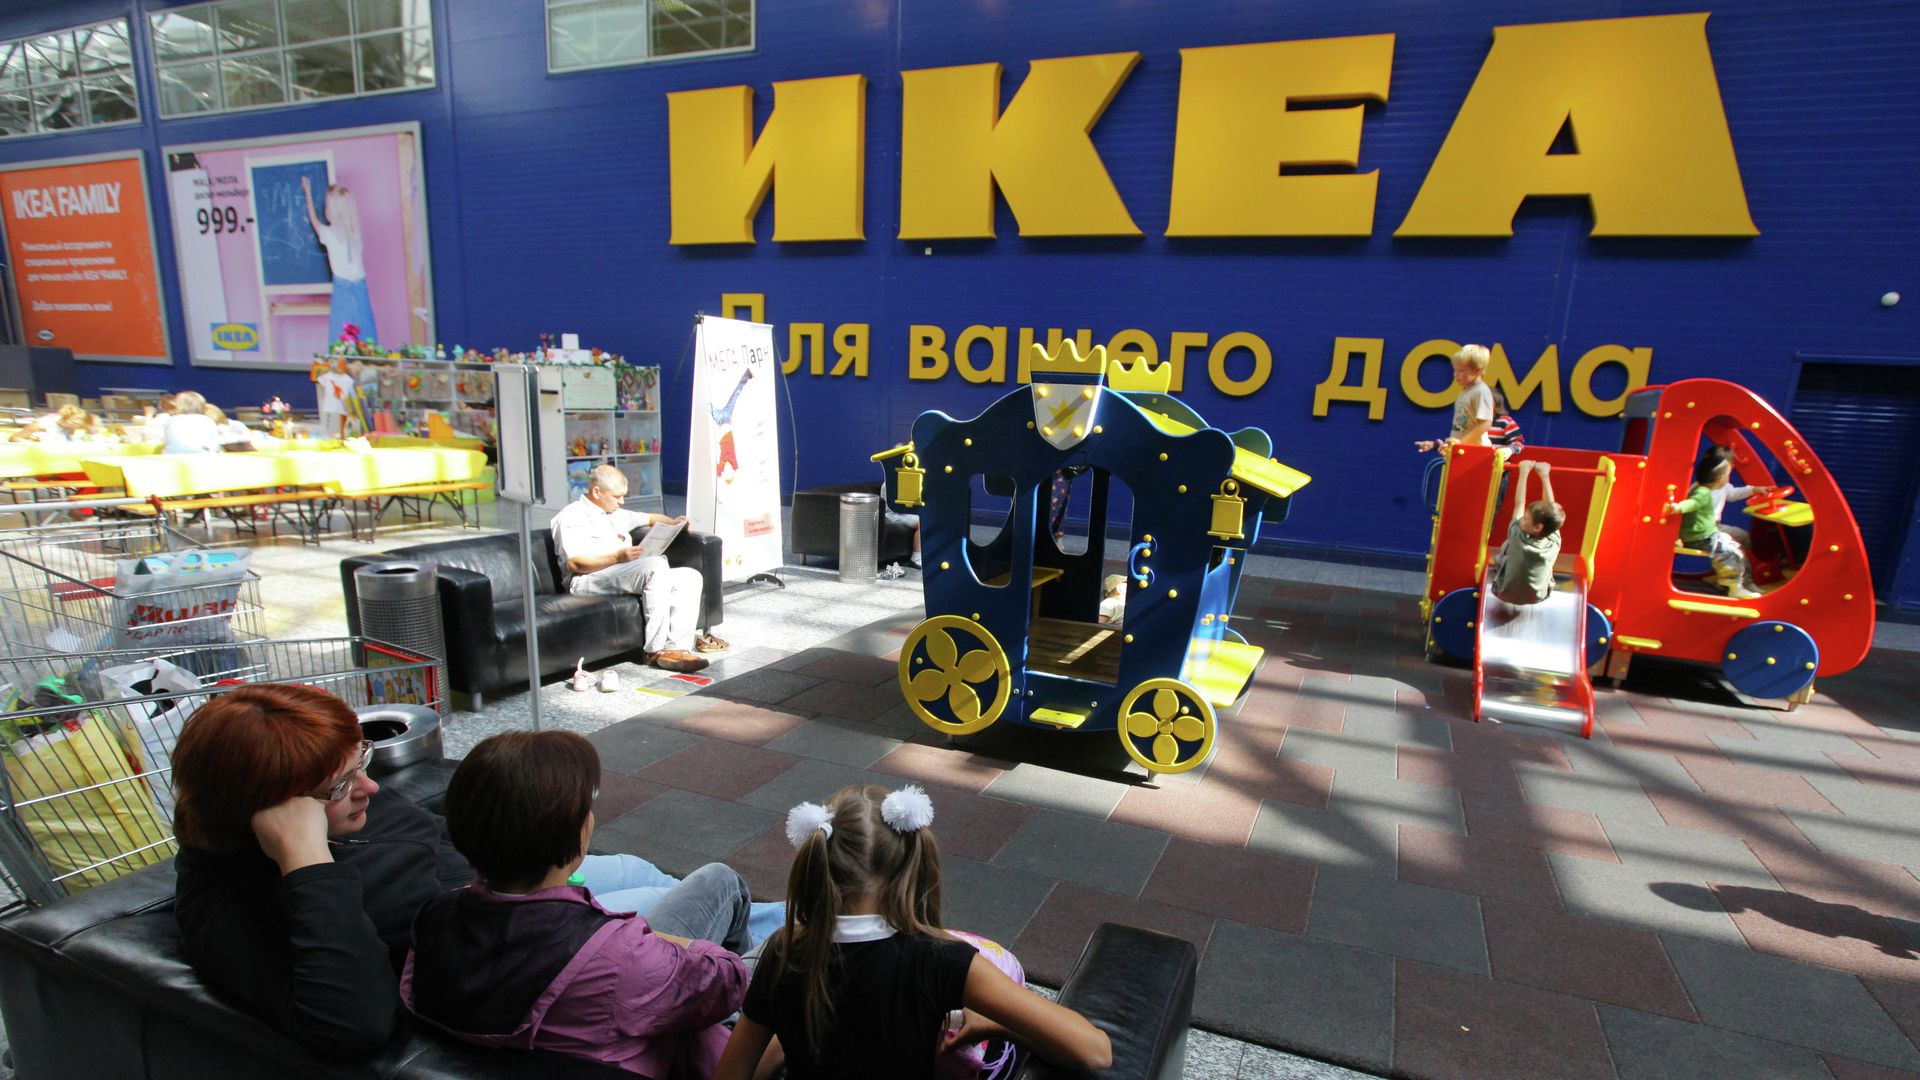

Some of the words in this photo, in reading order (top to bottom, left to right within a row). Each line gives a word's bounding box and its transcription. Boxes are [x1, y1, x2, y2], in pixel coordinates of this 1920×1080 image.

[666, 12, 1760, 246] ИКЕА
[12, 188, 58, 219] IKEA
[57, 182, 121, 216] FAMILY
[197, 206, 254, 235] 999.-
[217, 331, 253, 342] IKEA
[1312, 336, 1653, 421] дома
